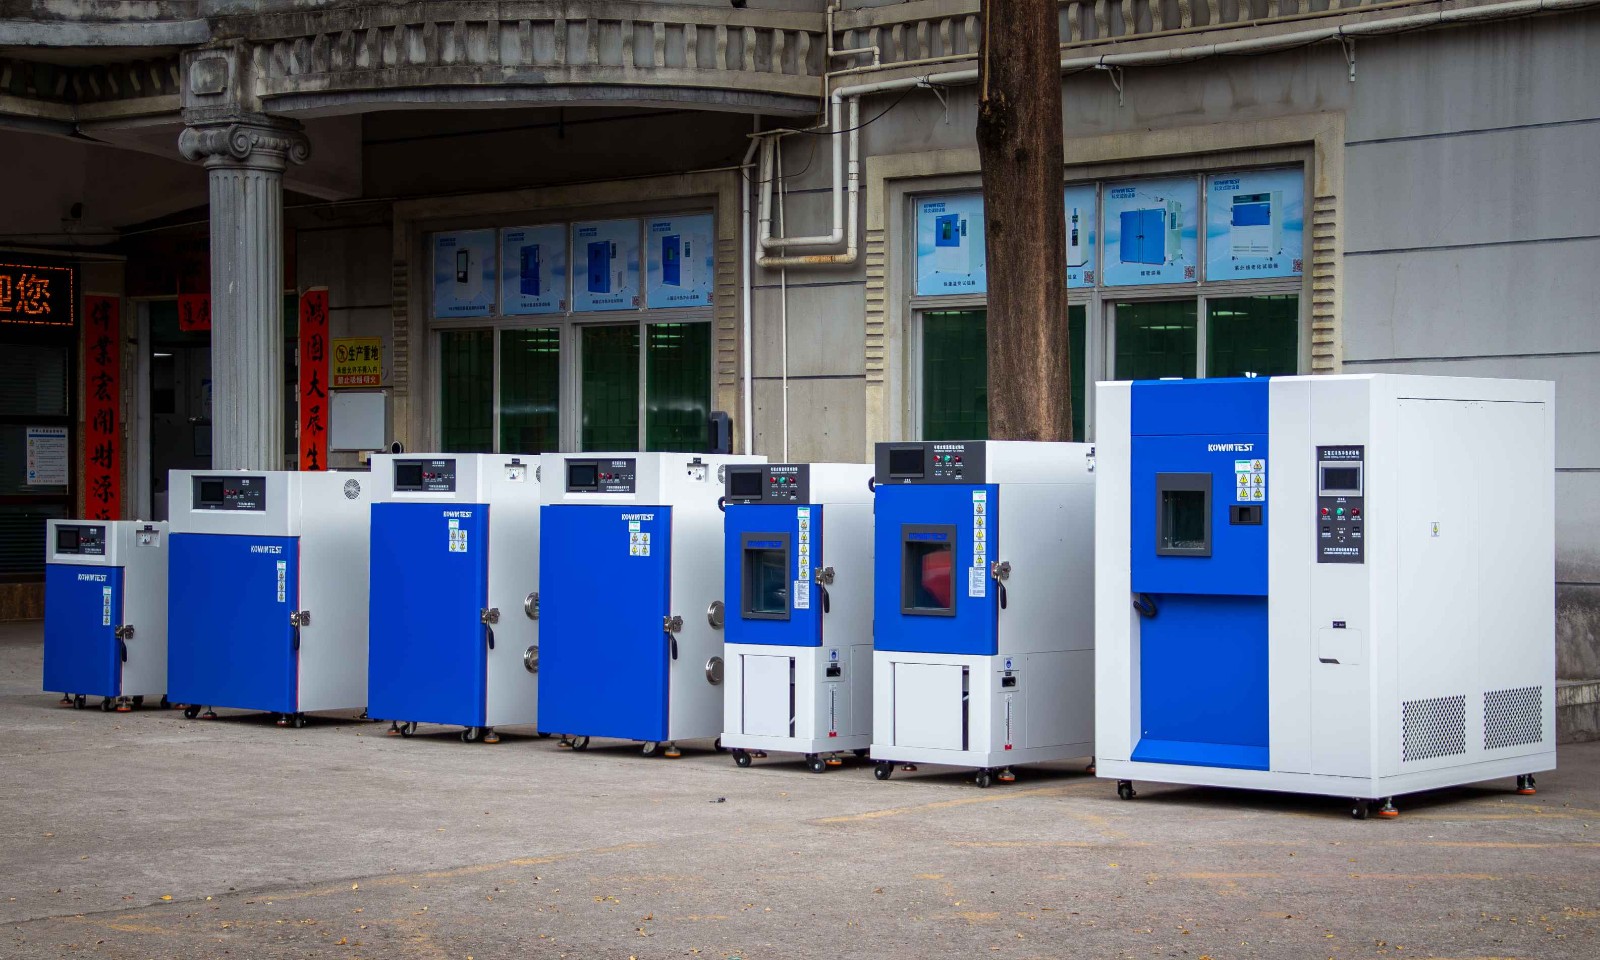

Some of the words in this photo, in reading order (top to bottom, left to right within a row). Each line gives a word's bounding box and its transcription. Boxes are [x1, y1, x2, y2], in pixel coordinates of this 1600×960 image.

[348, 345, 379, 361] 生产重地
[1207, 443, 1254, 452] KOWINTEST
[621, 513, 655, 521] KOWINTEST
[250, 545, 283, 554] KOWINTEST
[78, 573, 107, 582] KOWINTEST
